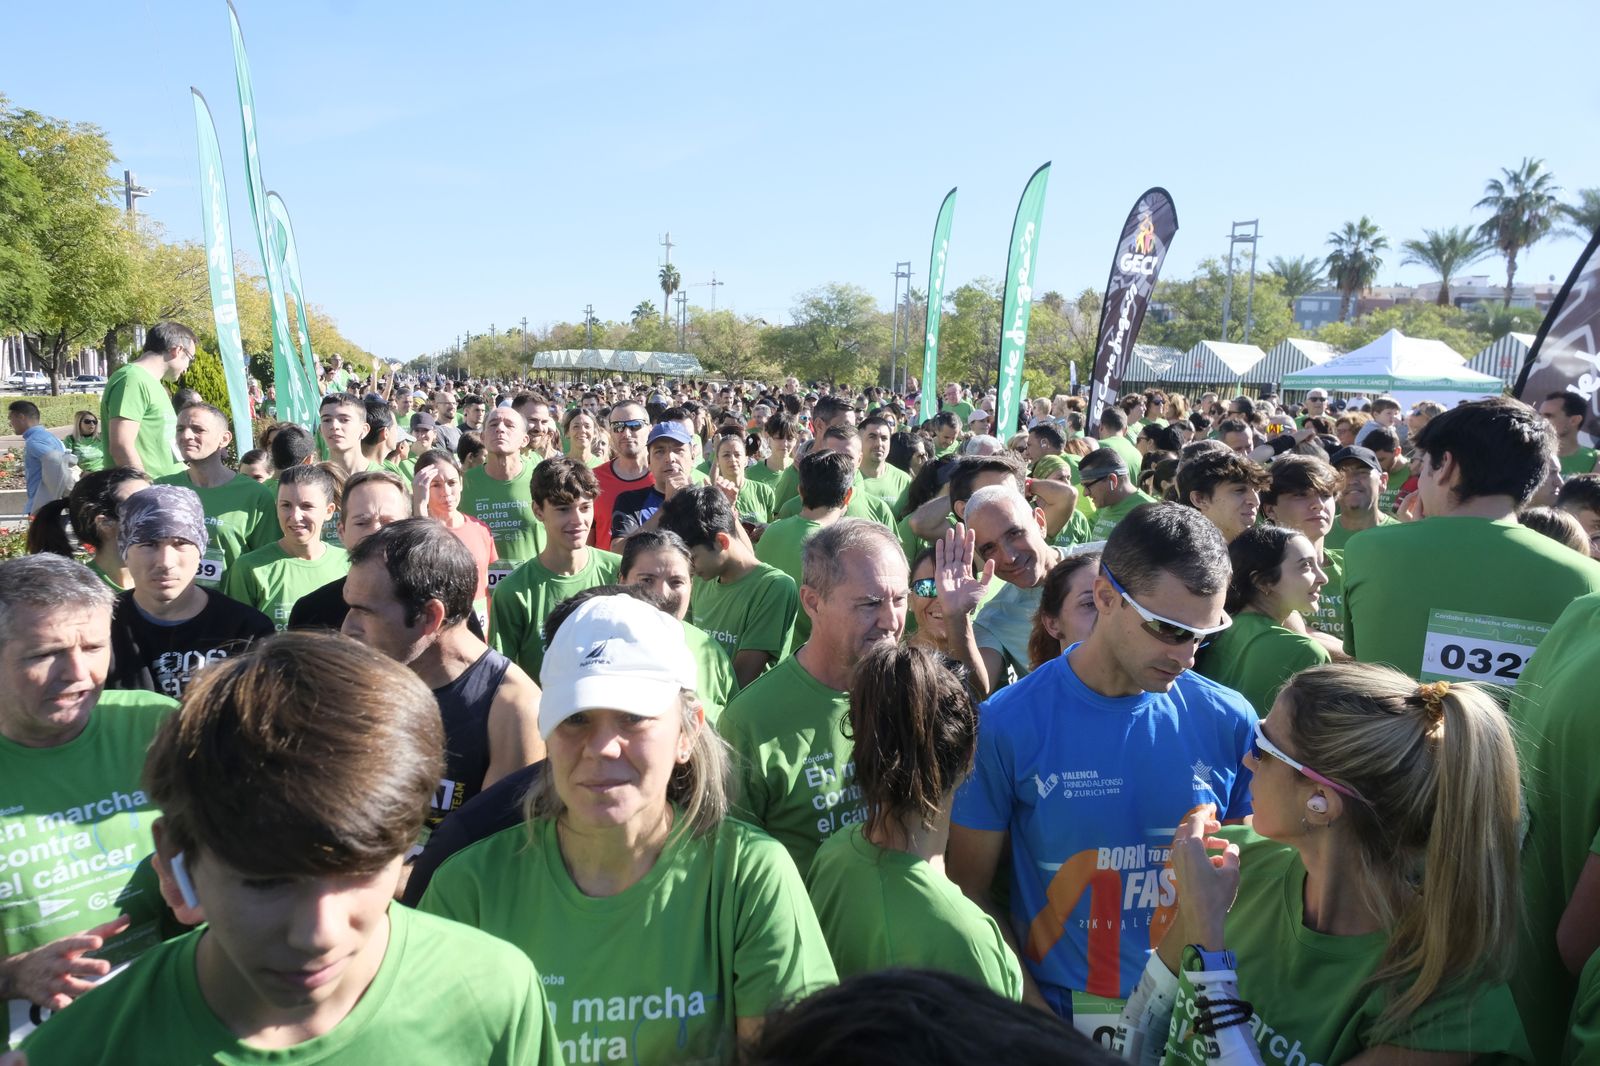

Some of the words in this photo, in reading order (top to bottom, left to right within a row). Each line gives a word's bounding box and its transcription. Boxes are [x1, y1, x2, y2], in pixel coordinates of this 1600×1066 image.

[1120, 252, 1158, 275] GECI
[476, 503, 489, 511] En
[492, 500, 529, 510] marcha
[477, 511, 509, 520] contra
[489, 519, 522, 529] cáncer
[1440, 644, 1530, 680] 032
[1061, 770, 1099, 780] VALENCIA
[1074, 789, 1106, 798] ZURICH
[36, 790, 148, 833] marcha
[817, 811, 835, 833] el
[32, 843, 137, 889] cáncer
[1096, 844, 1146, 871] BORN
[1148, 849, 1161, 863] TO
[1124, 869, 1177, 911] FAS
[571, 986, 706, 1024] marcha
[559, 1031, 627, 1064] ntra
